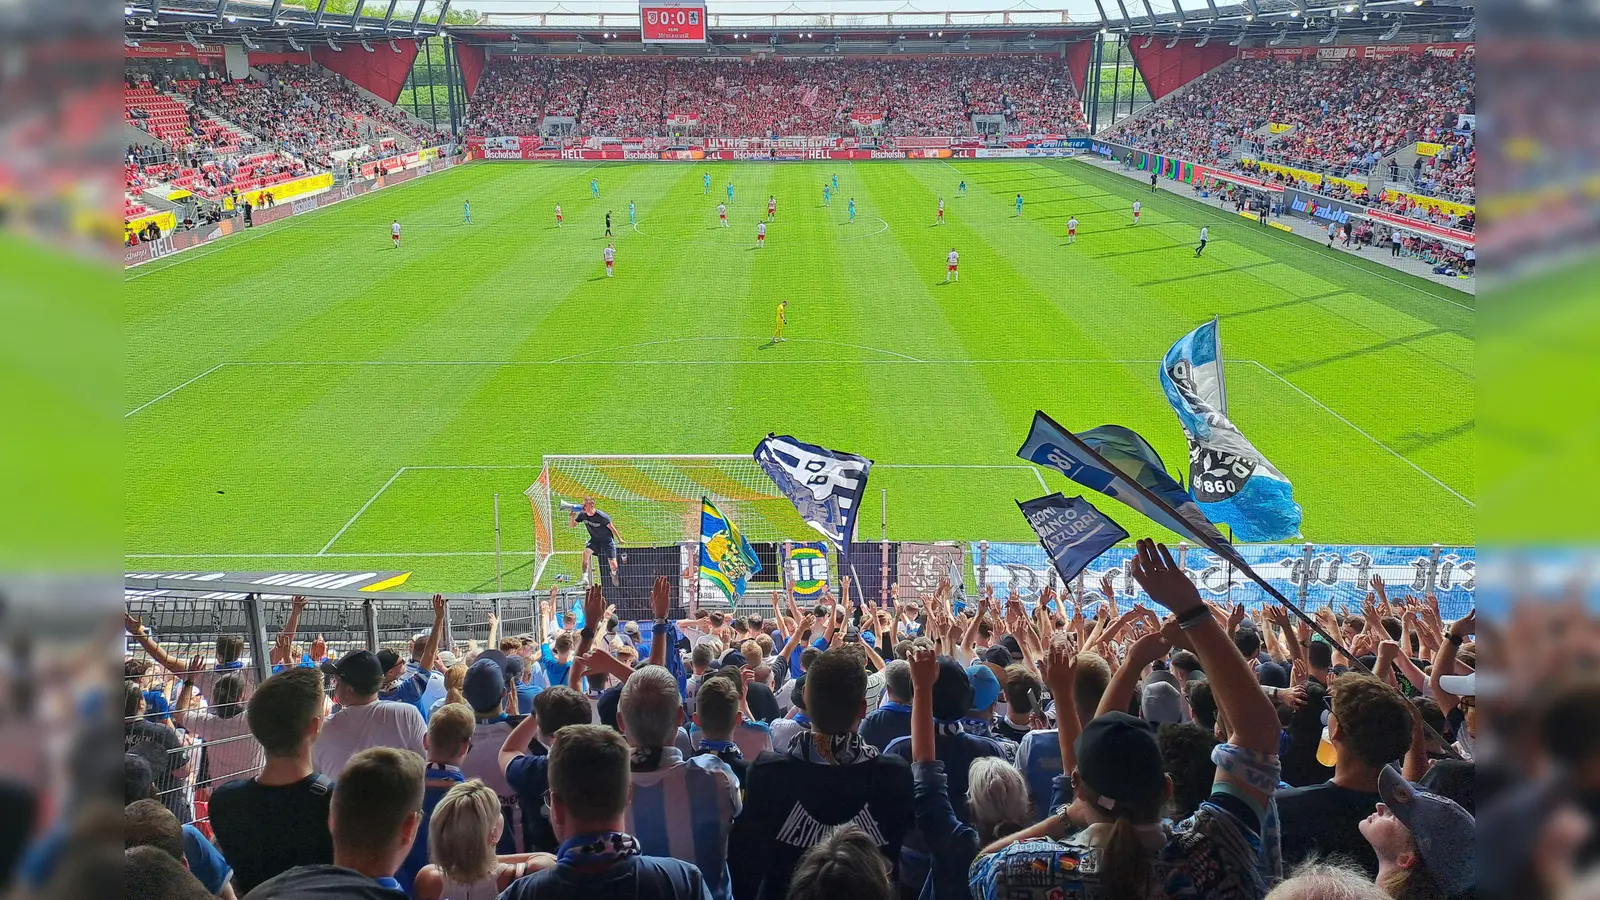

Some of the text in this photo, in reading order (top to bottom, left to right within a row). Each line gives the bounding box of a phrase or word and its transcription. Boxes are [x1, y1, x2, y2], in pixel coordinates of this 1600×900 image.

[561, 150, 585, 159] HELL
[808, 150, 832, 159] HELL
[149, 235, 178, 259] HELL
